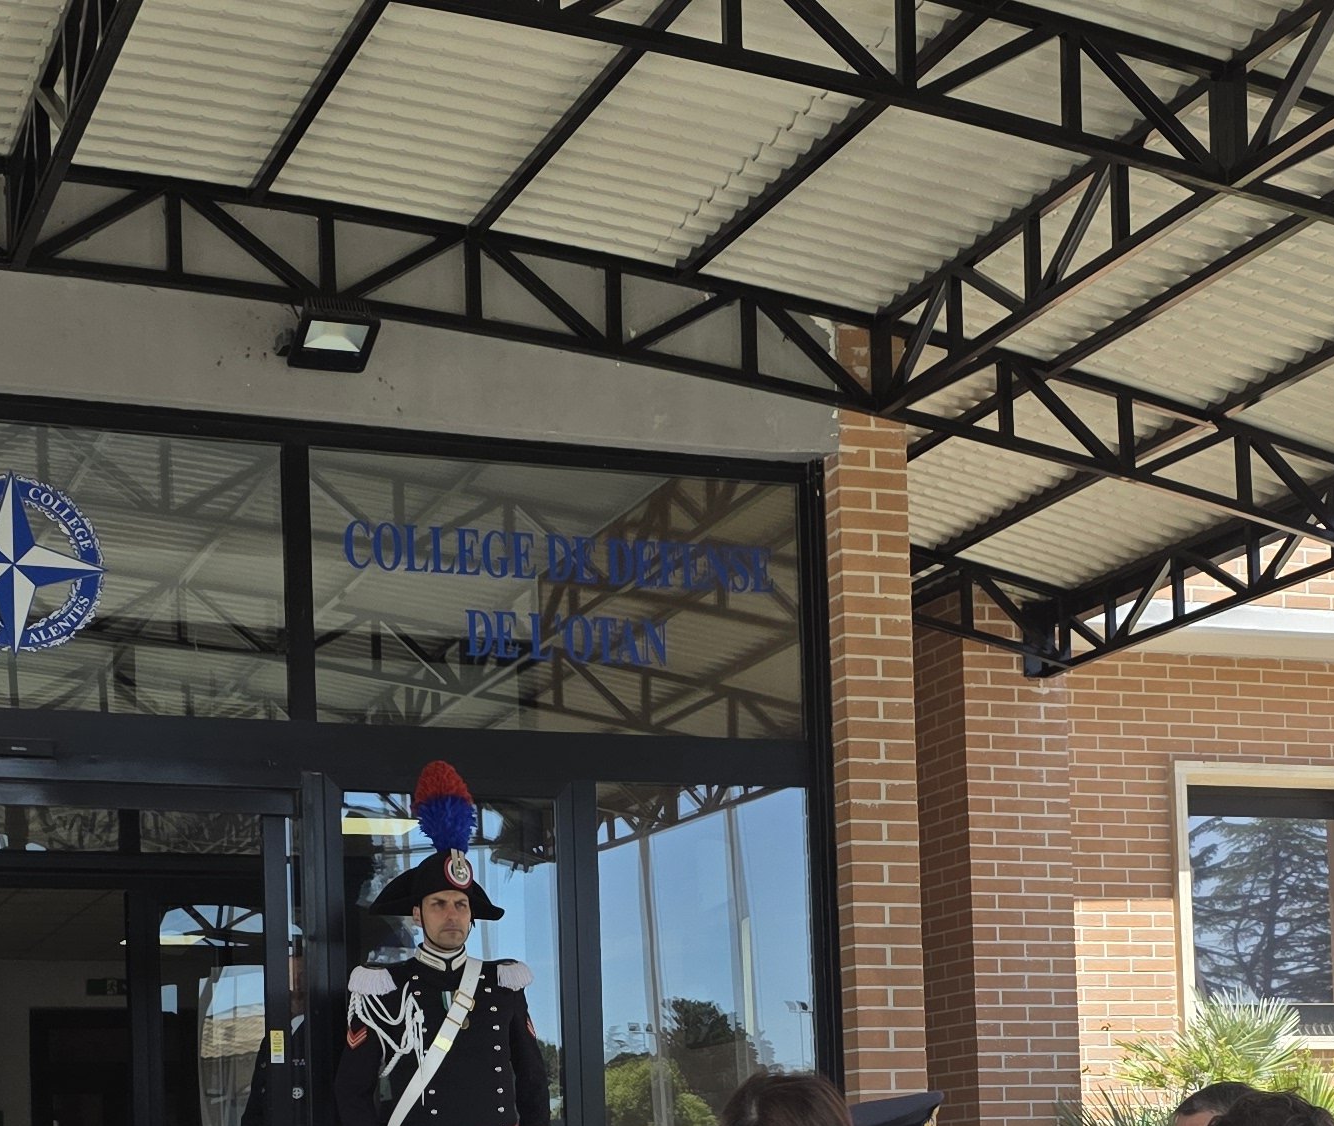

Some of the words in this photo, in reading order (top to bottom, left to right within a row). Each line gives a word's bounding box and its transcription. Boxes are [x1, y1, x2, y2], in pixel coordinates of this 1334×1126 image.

[28, 487, 93, 551] COLLEGE
[343, 519, 536, 580] COLLEGE
[545, 533, 598, 584] DE
[606, 537, 774, 593] DEFENSE
[28, 595, 90, 644] ALENTES
[464, 608, 522, 658] DE
[527, 611, 667, 667] L'OTAN
